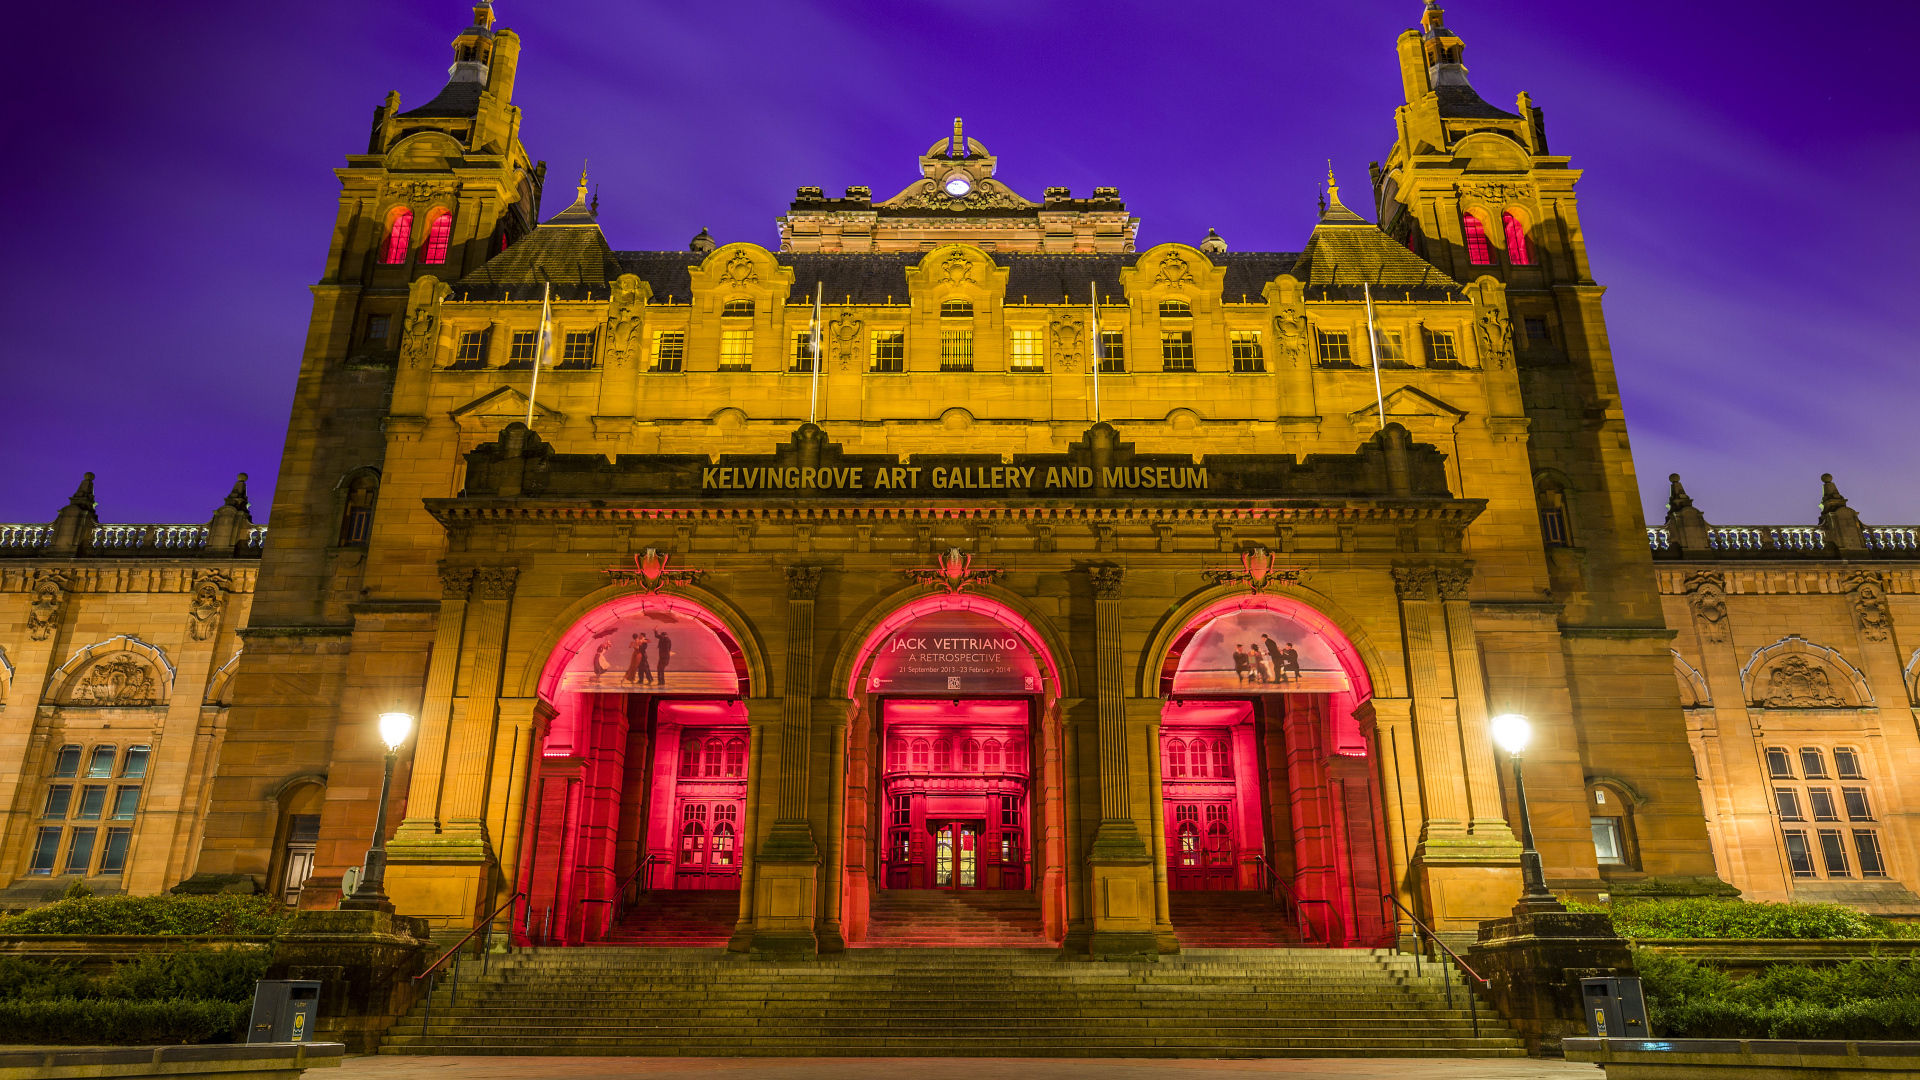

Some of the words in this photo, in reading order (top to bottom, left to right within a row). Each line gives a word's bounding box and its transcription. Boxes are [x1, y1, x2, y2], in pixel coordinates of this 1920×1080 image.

[702, 467, 863, 489] KELVINGROVE
[874, 467, 922, 489] ART
[932, 467, 1036, 489] GALLERY
[1045, 467, 1093, 488] AND
[1102, 467, 1208, 489] MUSEUM
[891, 638, 928, 652] JACK
[933, 638, 1018, 650] VETTRIANO
[908, 653, 917, 662] A
[920, 653, 1001, 662] RETROSPECTIVE
[908, 666, 940, 674] September
[968, 666, 995, 674] February
